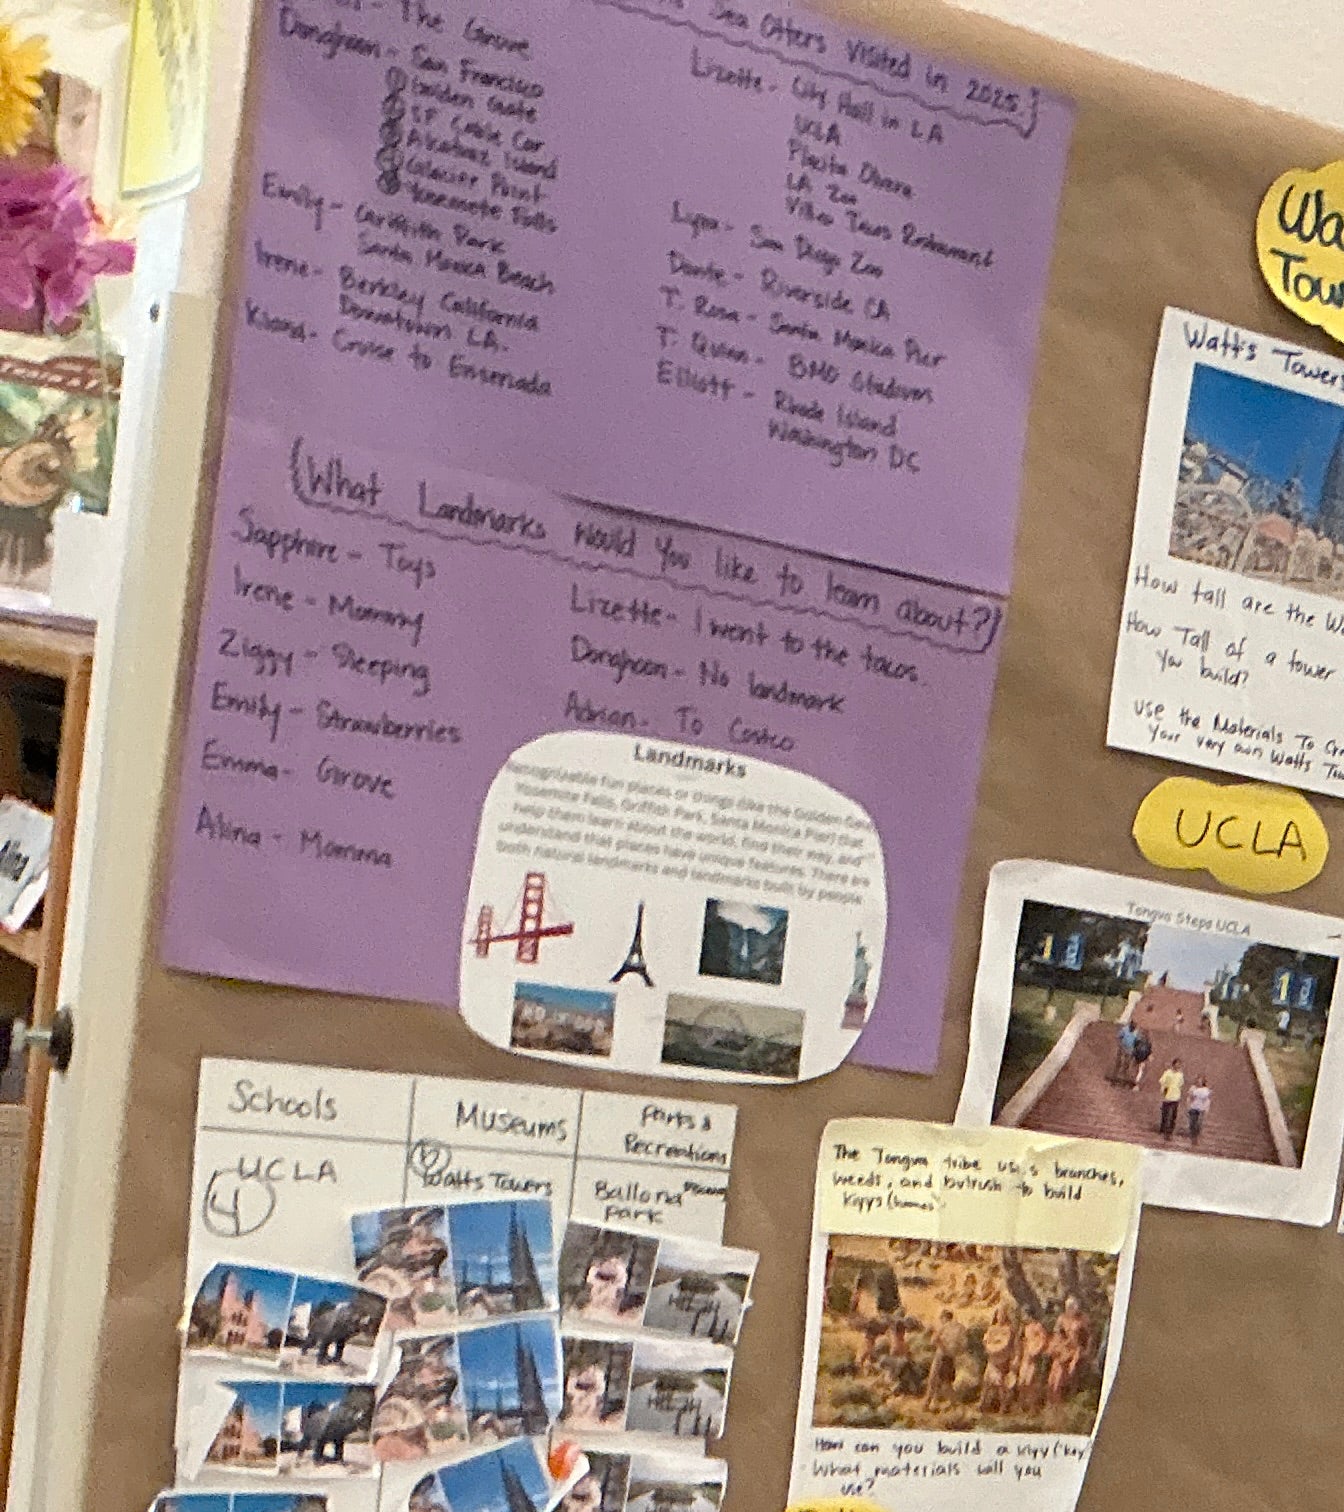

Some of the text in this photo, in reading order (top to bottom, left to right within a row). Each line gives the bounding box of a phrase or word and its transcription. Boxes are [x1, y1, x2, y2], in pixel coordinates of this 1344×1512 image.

[911, 120, 944, 146] LA
[417, 478, 548, 541] Landmarks
[776, 560, 806, 597] to
[1132, 564, 1179, 596] How
[1191, 580, 1228, 610] tall
[1241, 595, 1276, 617] are
[1285, 599, 1317, 629] the
[811, 634, 851, 668] the
[1124, 610, 1163, 639] How
[1225, 635, 1250, 660] of
[1287, 650, 1339, 682] tower
[1178, 705, 1201, 731] the
[633, 742, 747, 779] Landmarks
[1174, 807, 1309, 863] UCLA
[1175, 910, 1213, 931] Steps
[1216, 918, 1251, 937] UCLA
[227, 1079, 339, 1123] Schools
[455, 1099, 568, 1143] Museums
[231, 1155, 337, 1185] UCLA
[832, 1143, 861, 1162] The
[943, 1153, 982, 1171] tribe
[489, 1171, 553, 1196] Towers
[899, 1174, 934, 1190] and
[1042, 1183, 1083, 1202] build
[210, 1190, 242, 1235] 4
[853, 1441, 881, 1455] can
[892, 1441, 925, 1460] you
[937, 1439, 983, 1457] build
[812, 1459, 1044, 1481] What materials will you
